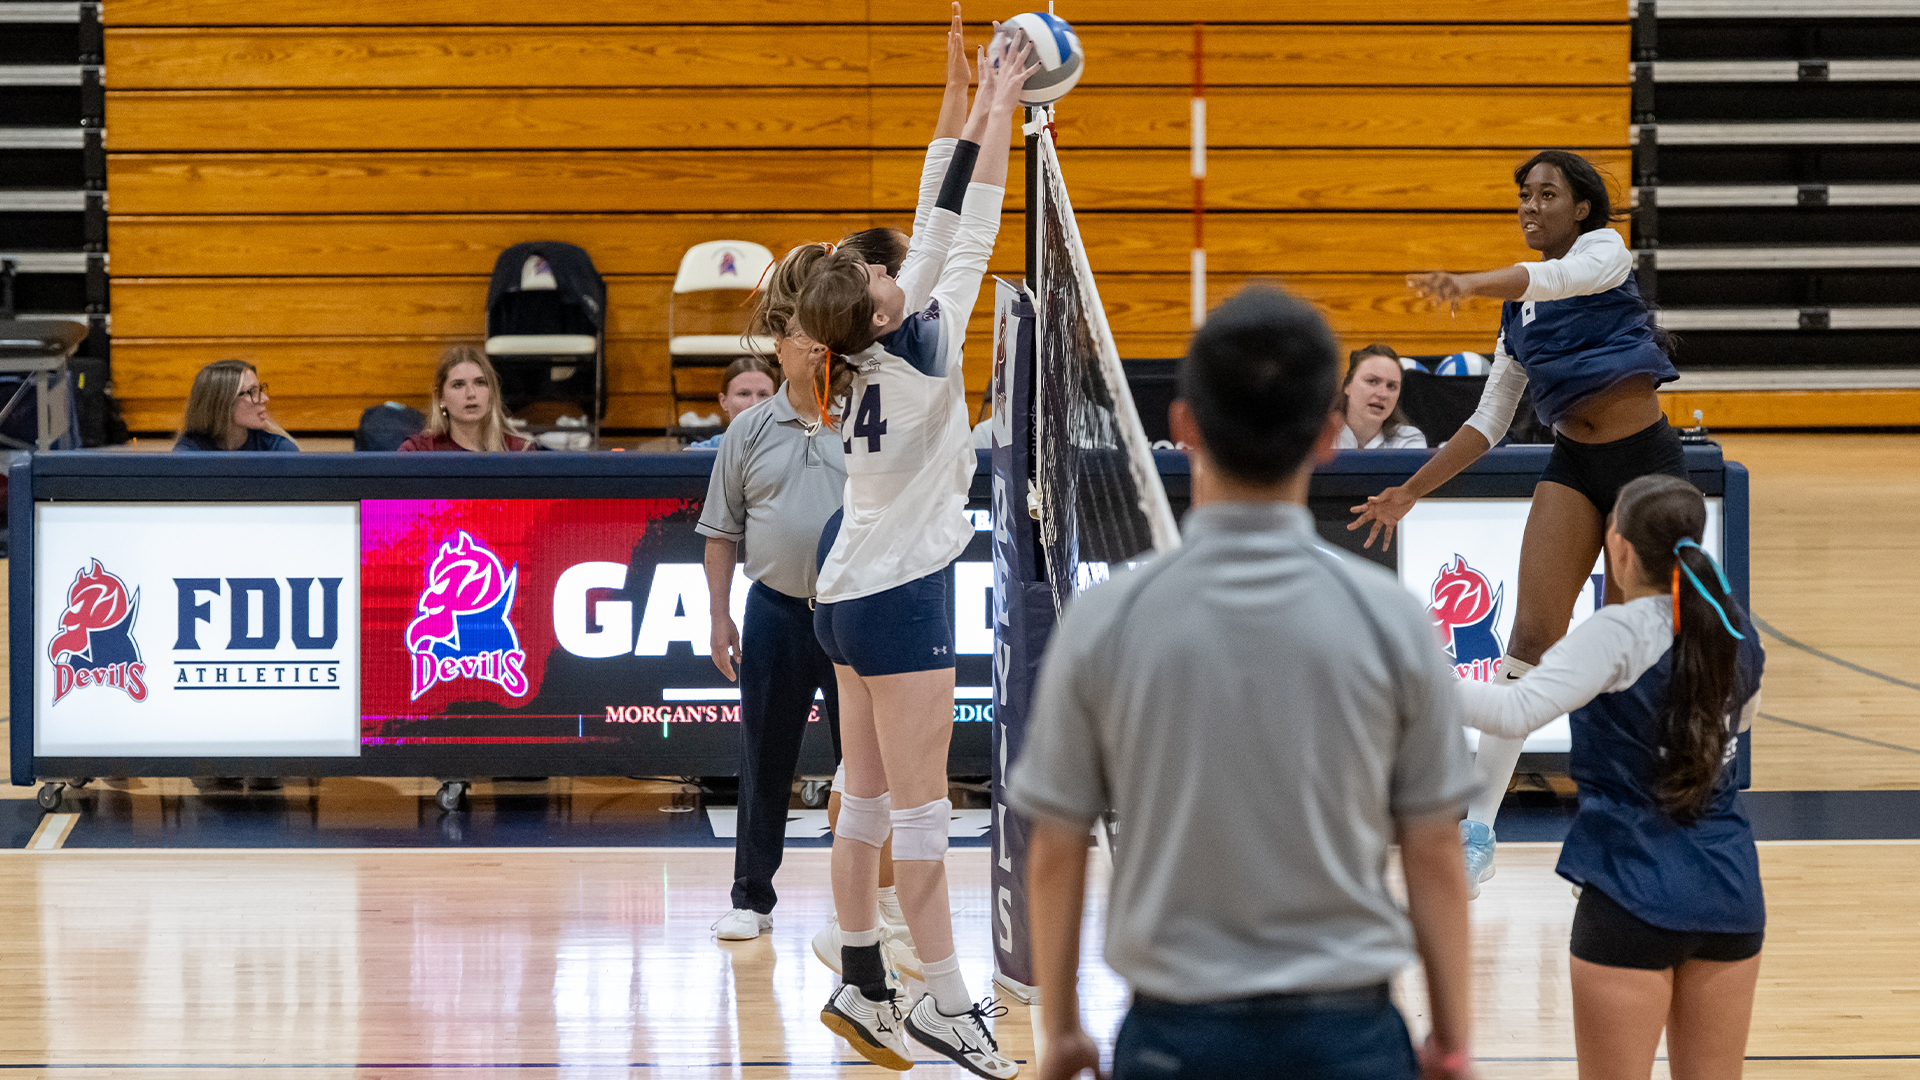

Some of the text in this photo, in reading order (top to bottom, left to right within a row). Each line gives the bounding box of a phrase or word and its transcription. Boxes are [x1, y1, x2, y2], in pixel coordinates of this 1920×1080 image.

[172, 577, 343, 650] FDU
[177, 667, 338, 682] ATHLETICS
[605, 705, 717, 723] MORGAN'S
[994, 474, 1013, 954] DEVILS
